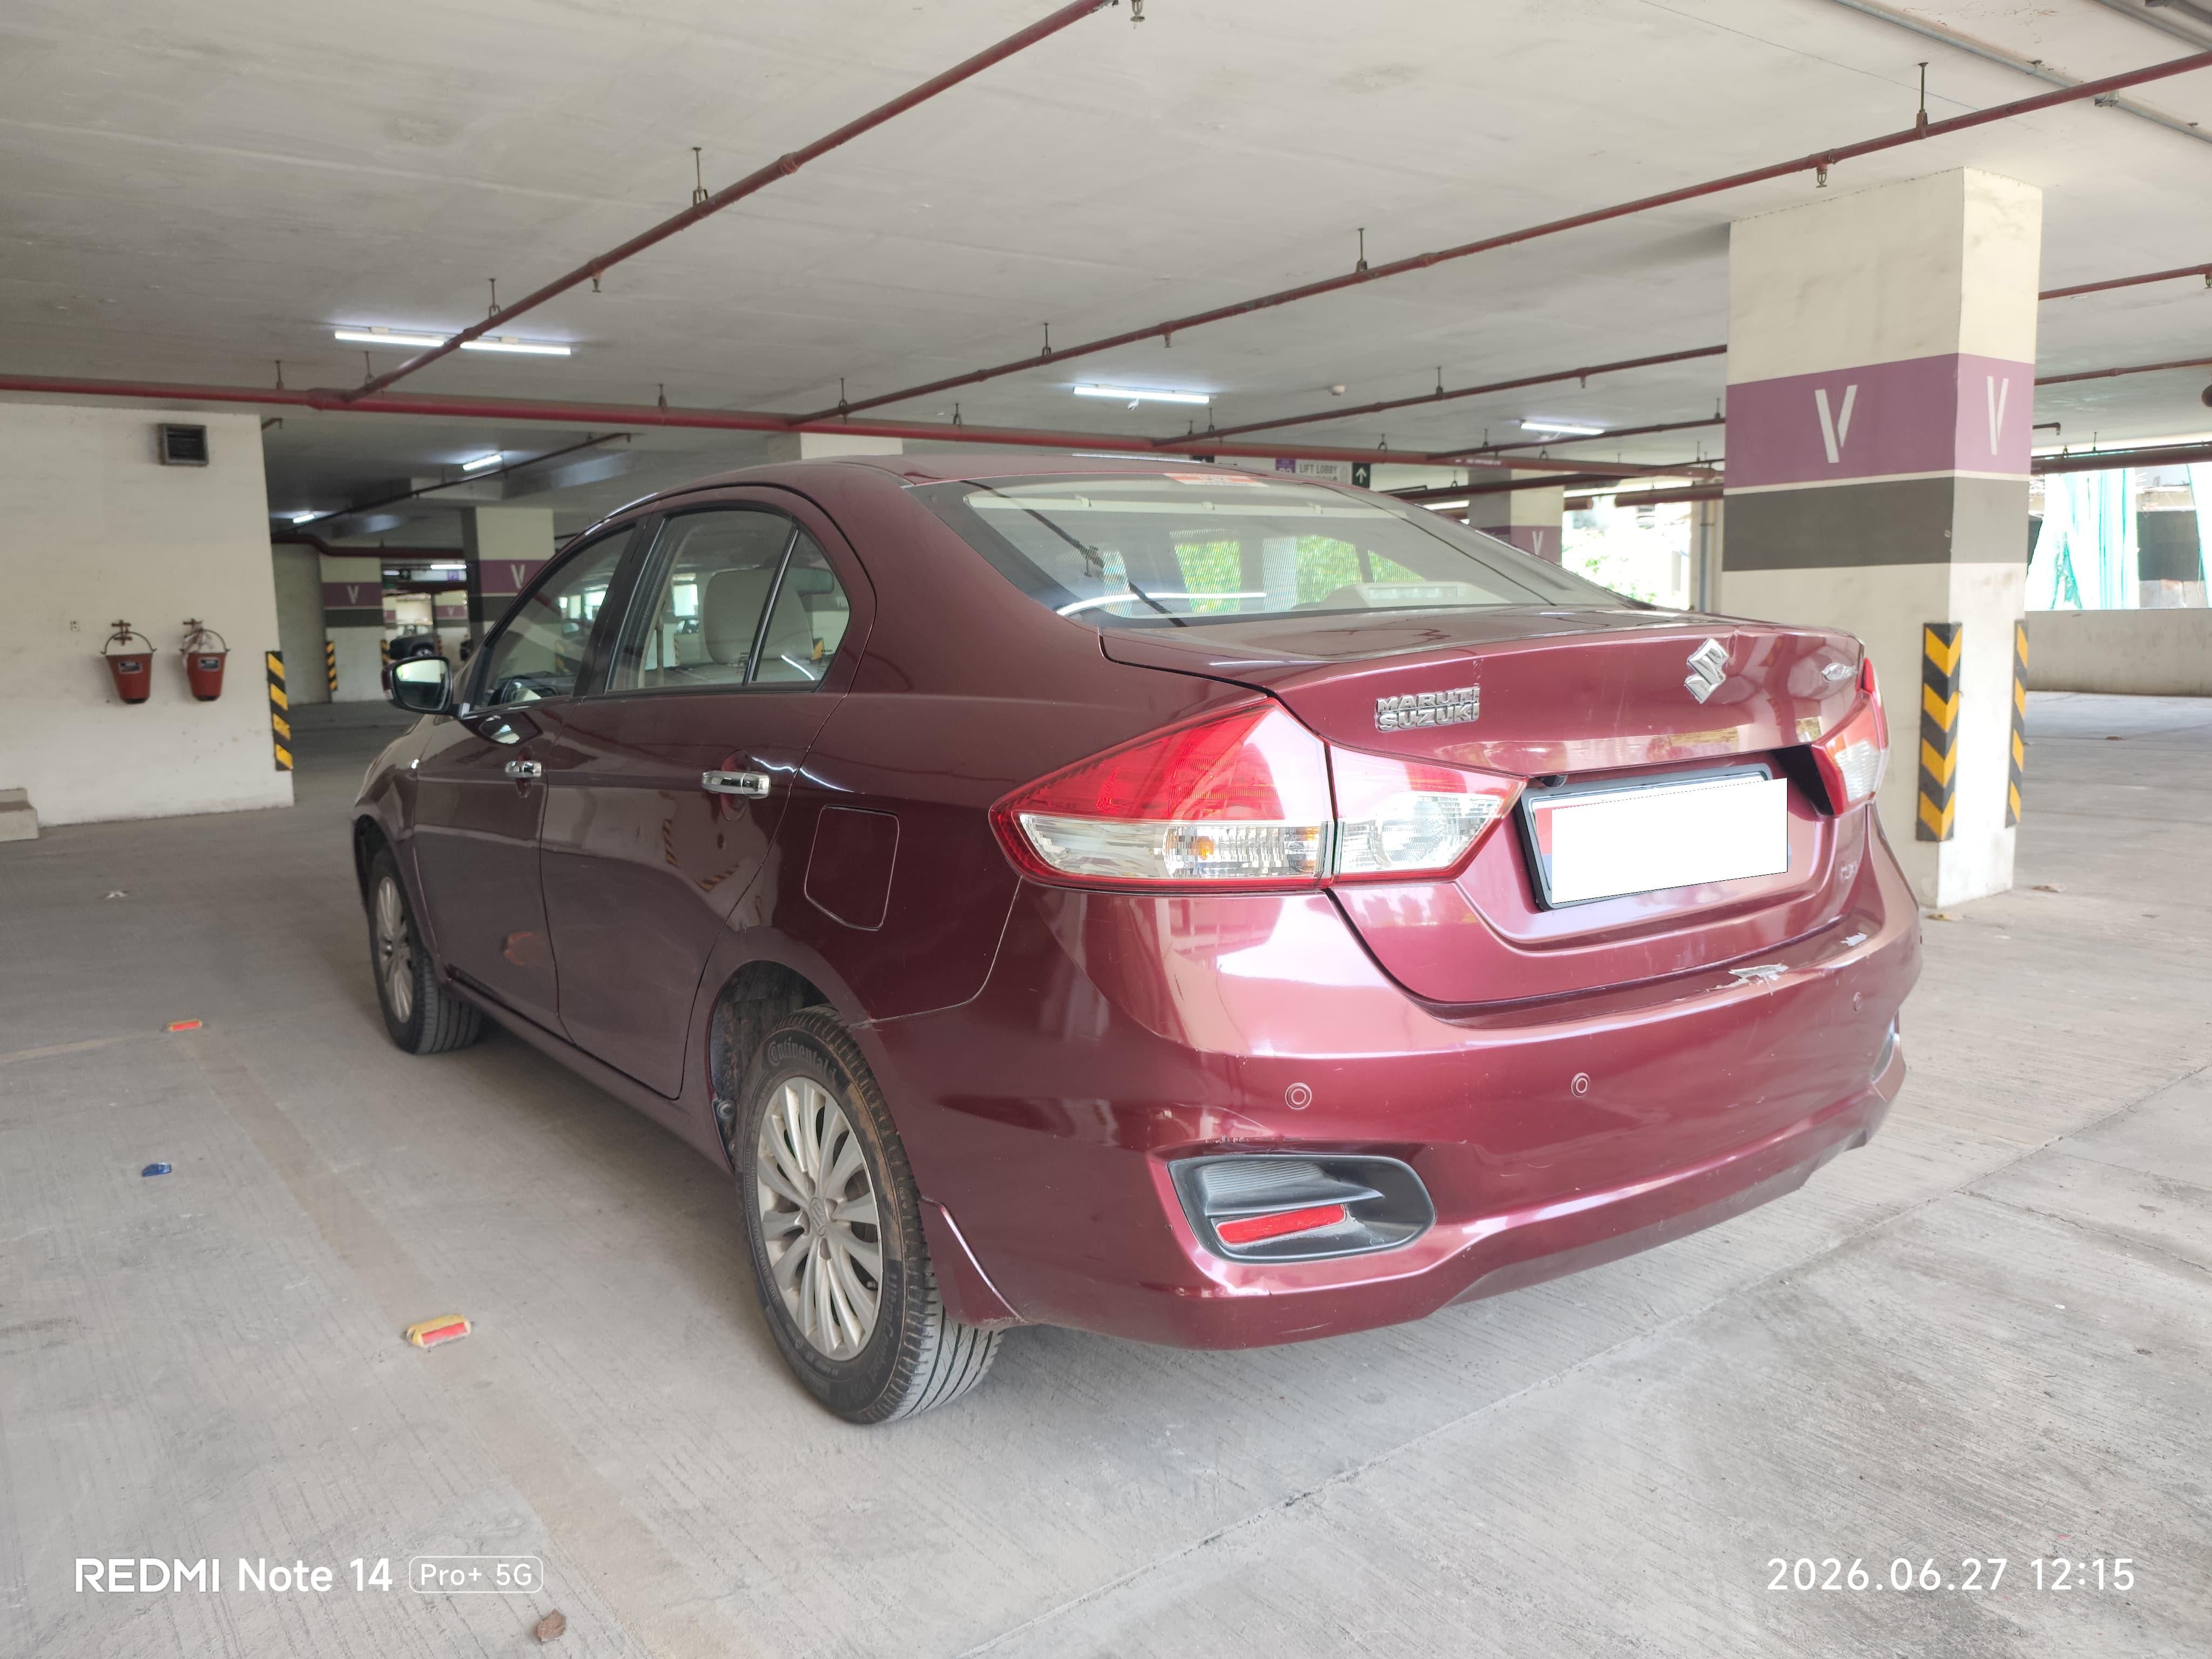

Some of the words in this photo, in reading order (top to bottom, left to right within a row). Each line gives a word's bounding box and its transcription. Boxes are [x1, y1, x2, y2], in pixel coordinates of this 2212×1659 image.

[1815, 384, 1858, 463] V
[1986, 375, 2009, 456] V
[1299, 464, 1314, 473] LIFT
[1532, 531, 1544, 555] V
[510, 563, 526, 589] V
[346, 584, 359, 604] V
[1377, 686, 1480, 713] MARUTI
[1377, 703, 1480, 731] SUZUKI
[768, 1036, 829, 1076] Continental
